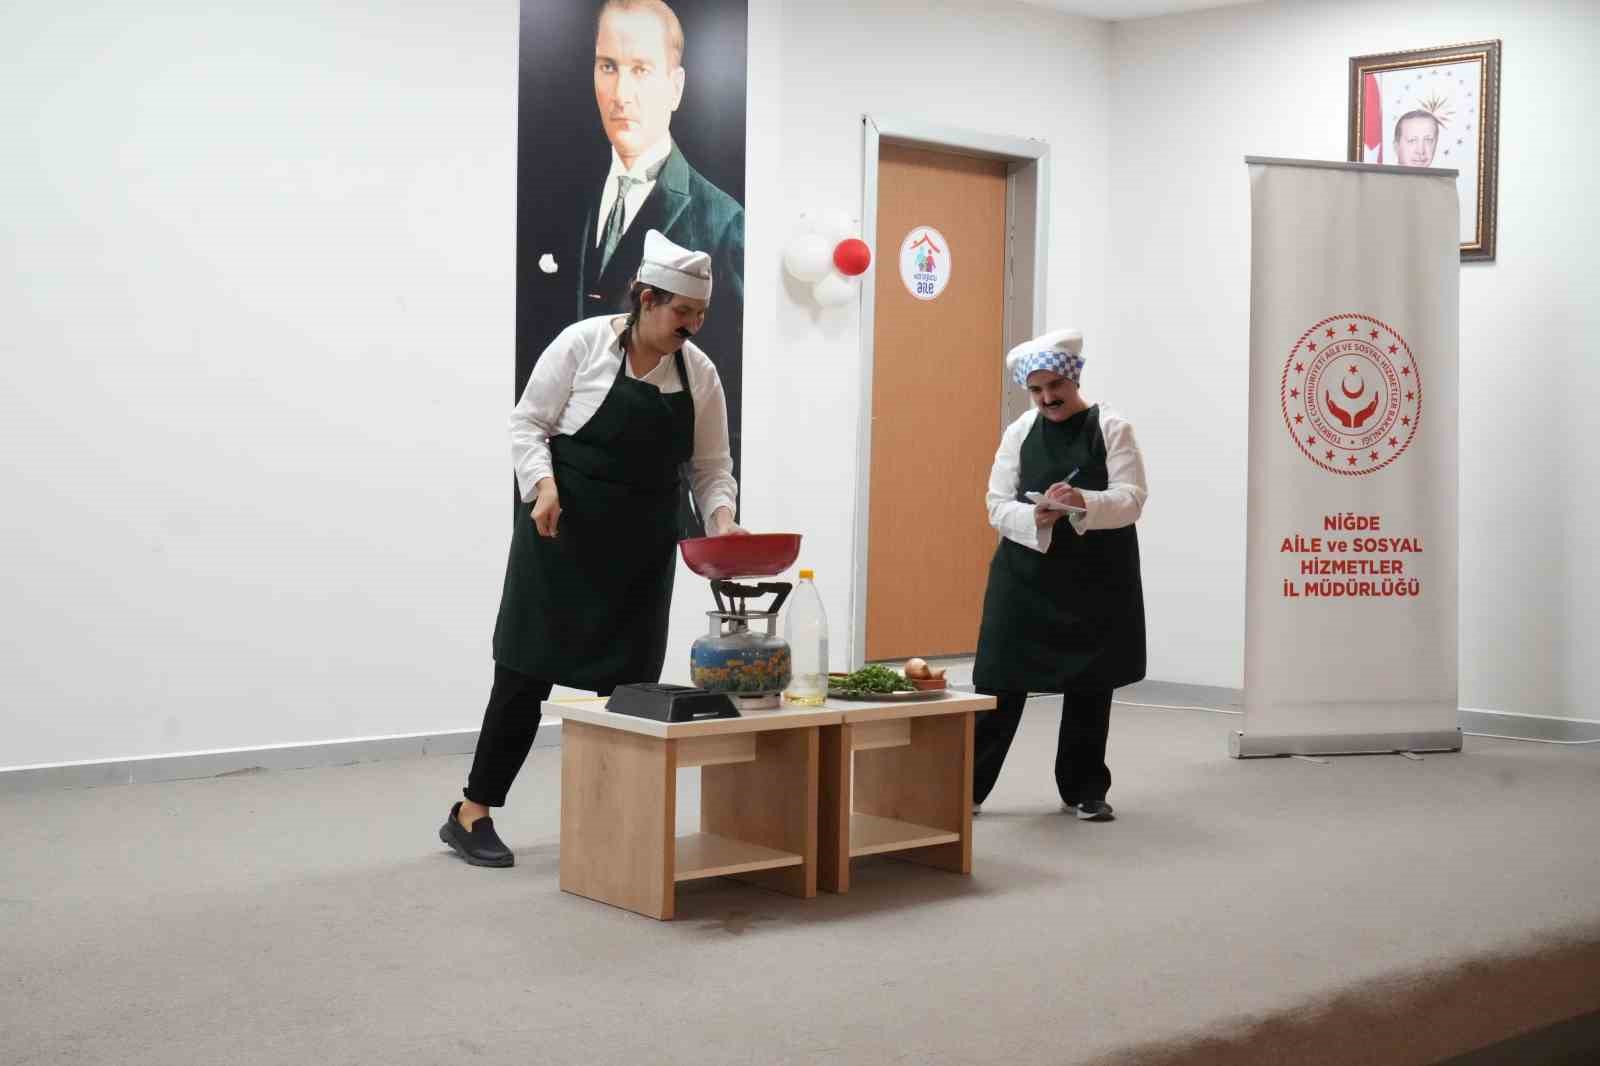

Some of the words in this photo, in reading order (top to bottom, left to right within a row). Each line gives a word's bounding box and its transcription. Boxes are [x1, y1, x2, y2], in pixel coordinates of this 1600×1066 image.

[1324, 512, 1380, 531] NİĞDE
[1280, 534, 1322, 552] AİLE
[1327, 540, 1348, 552] ve
[1353, 538, 1423, 552] SOSYAL
[1301, 556, 1403, 574] HİZMETLER
[1283, 579, 1299, 596] İL
[1305, 578, 1420, 596] MÜDÜRLÜĞÜ
